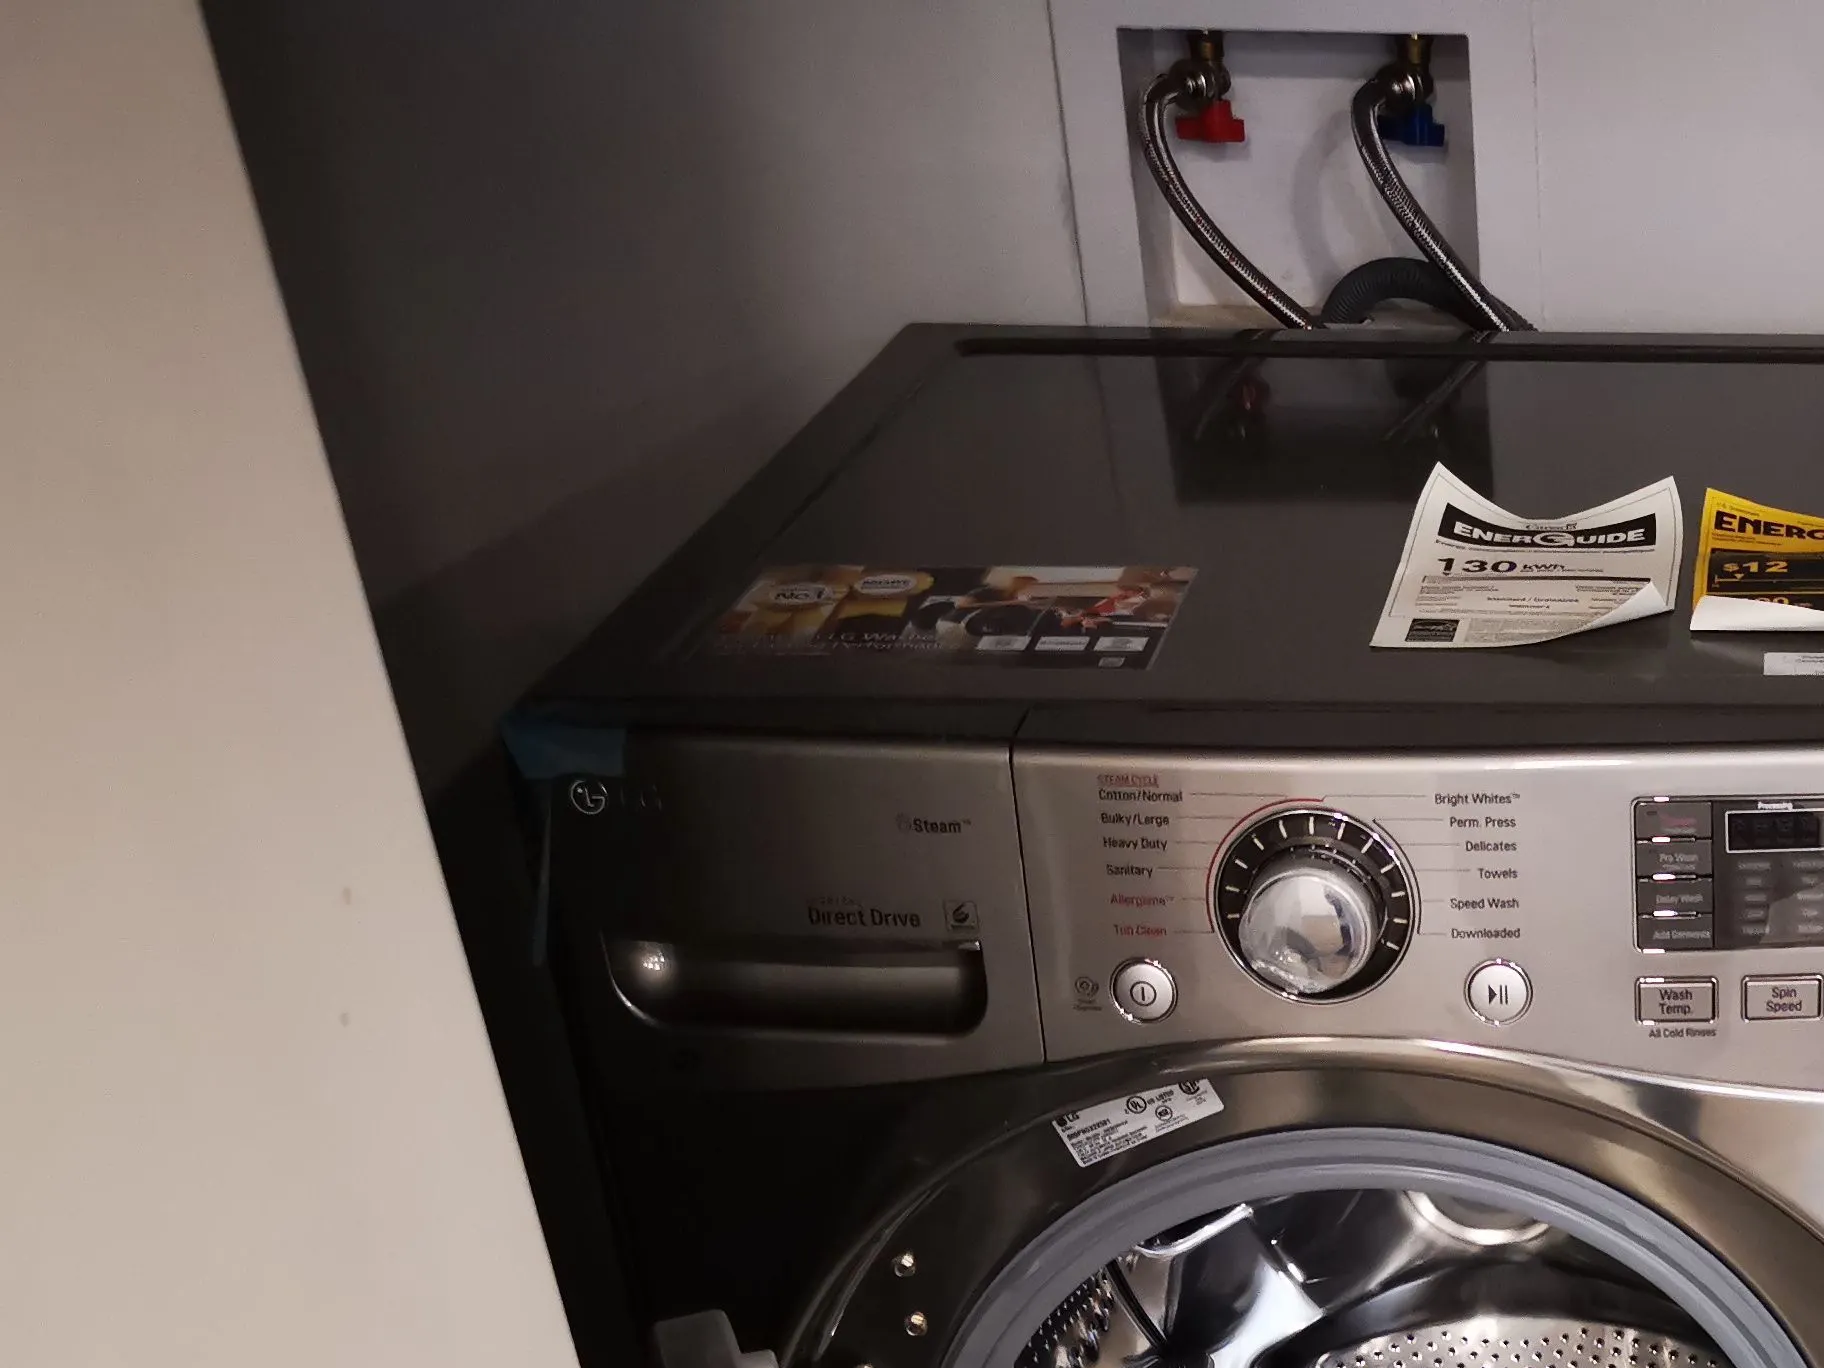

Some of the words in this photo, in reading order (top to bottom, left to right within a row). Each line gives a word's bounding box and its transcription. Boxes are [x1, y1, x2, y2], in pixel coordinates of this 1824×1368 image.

[1453, 521, 1646, 547] ENERGUIDE
[1437, 557, 1518, 573] 130
[1722, 560, 1789, 574] $12
[1098, 788, 1183, 802] Cotton/Normal
[1435, 793, 1469, 807] Bright
[1101, 812, 1170, 827] Bulky/Large
[1485, 816, 1517, 828] Press
[1103, 836, 1138, 850] Heavy
[1141, 837, 1168, 851] Duty
[1465, 840, 1518, 852] Delicates
[1106, 863, 1153, 878] Sanitary
[1477, 867, 1519, 879] Towels
[1450, 897, 1485, 911] Speed
[1487, 897, 1520, 909] Wash
[807, 906, 867, 927] Direct
[870, 908, 921, 928] Drive
[1451, 928, 1521, 939] Downloaded
[1659, 988, 1693, 1001] Wash
[1771, 986, 1797, 999] Spin
[1766, 1000, 1802, 1013] Speed
[1663, 1027, 1684, 1038] Cold
